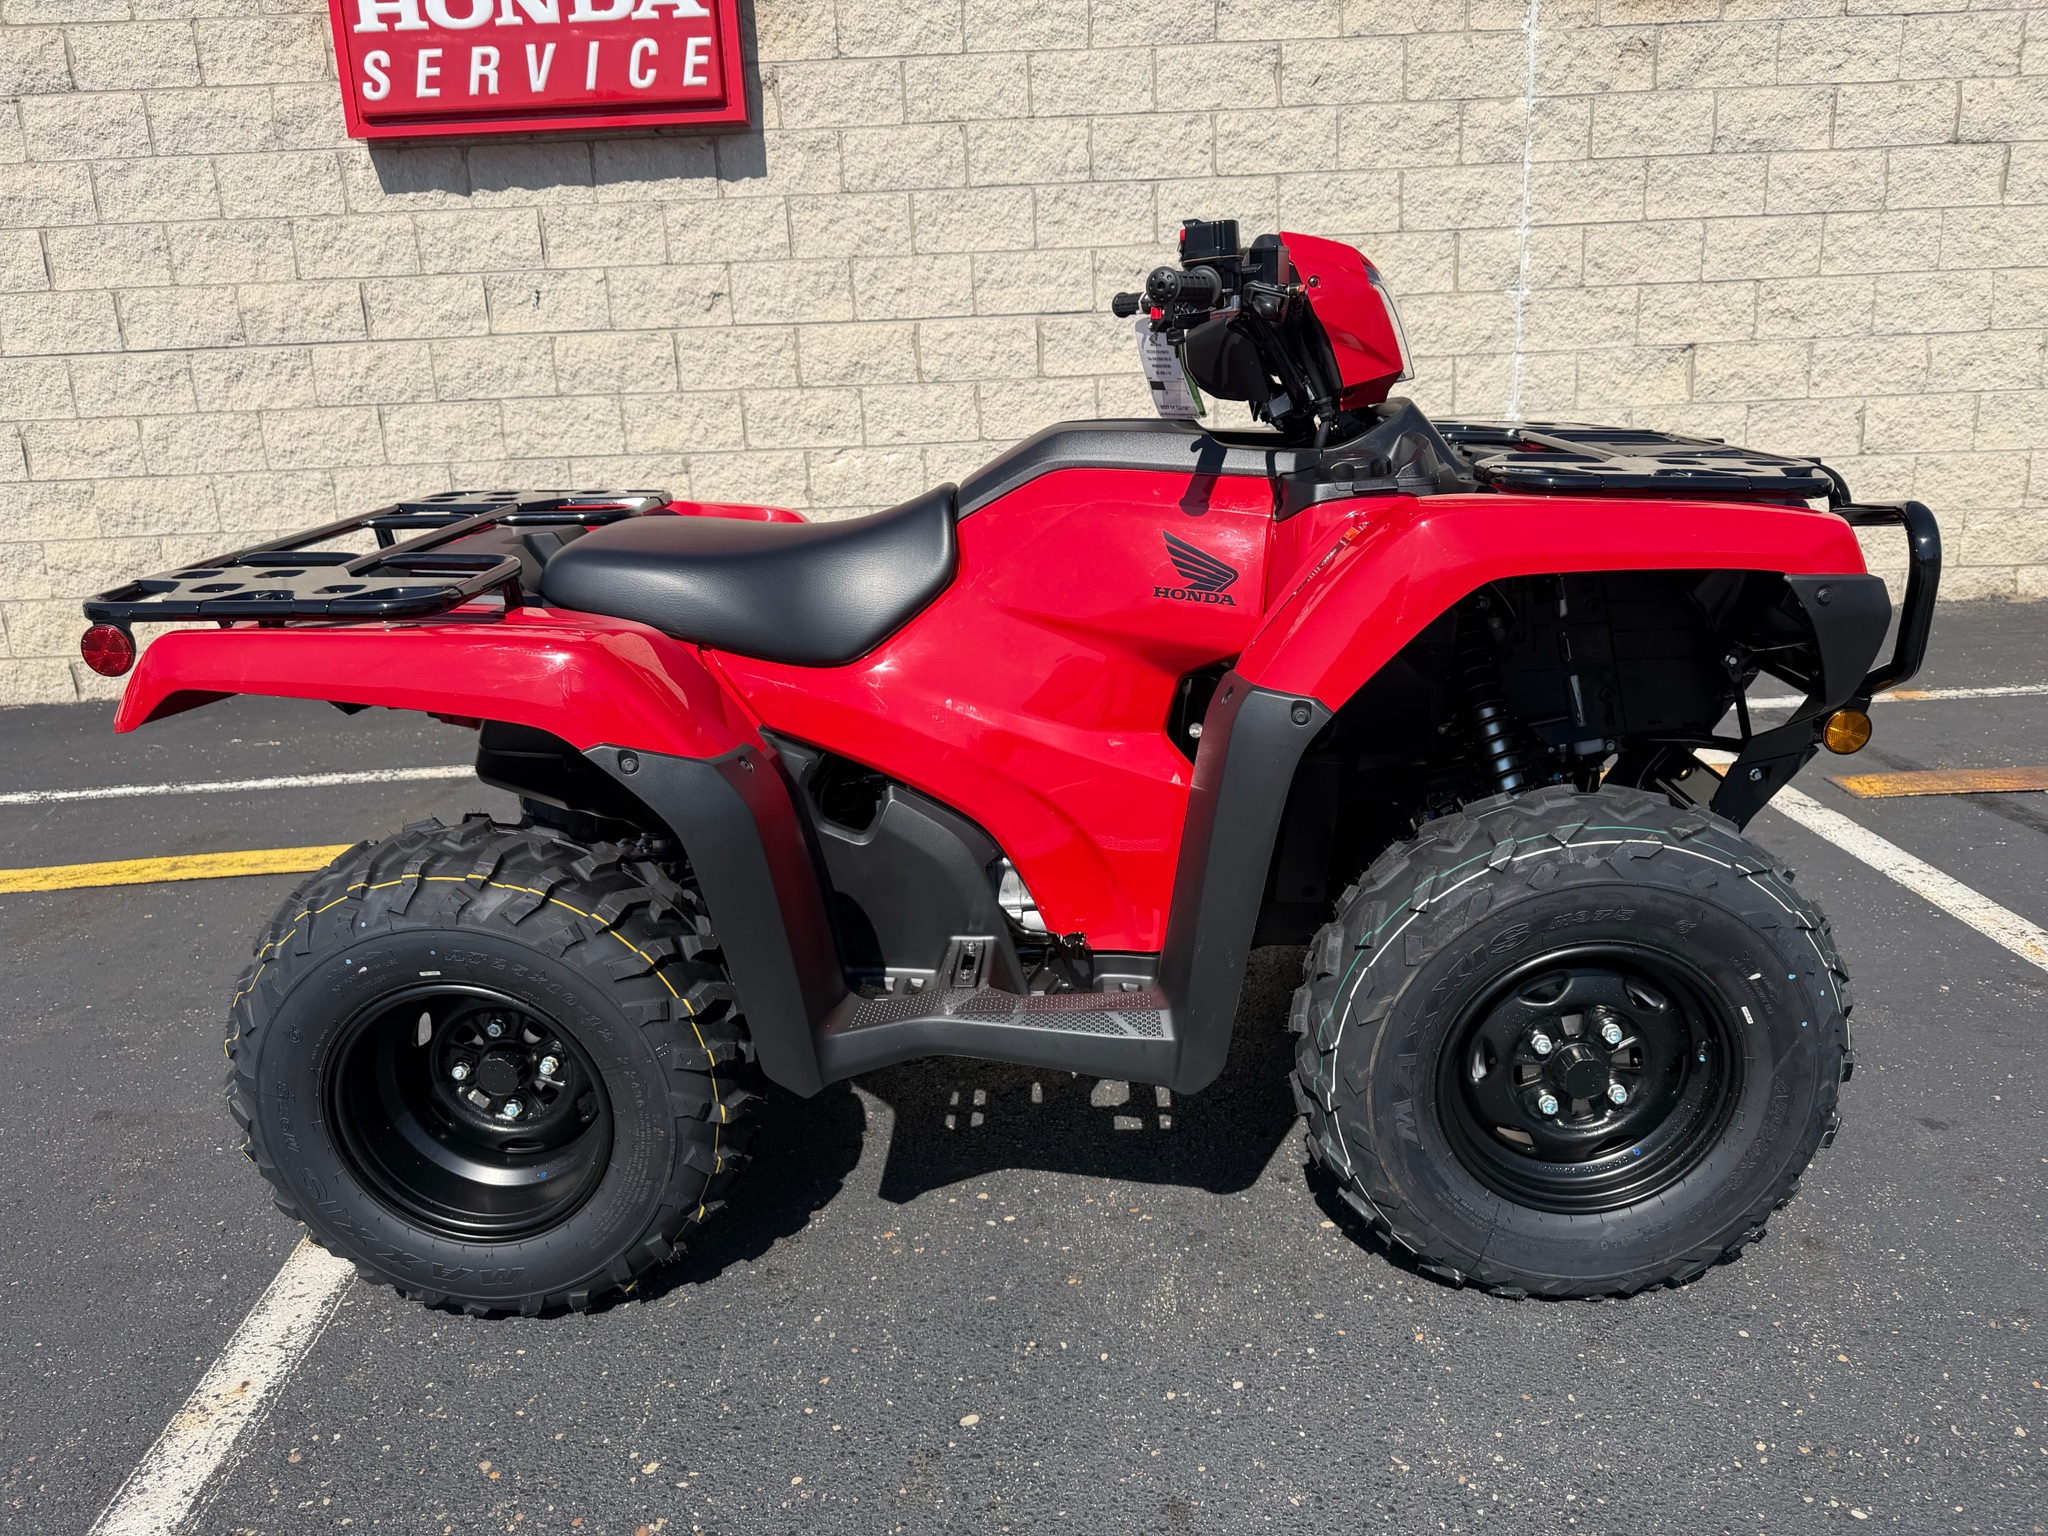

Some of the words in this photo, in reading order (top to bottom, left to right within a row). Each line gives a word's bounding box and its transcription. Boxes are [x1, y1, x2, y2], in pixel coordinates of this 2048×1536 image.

[362, 36, 712, 100] SERVICE
[1153, 587, 1237, 606] HONDA
[1393, 923, 1531, 1148] MAXXIS
[1549, 908, 1636, 931] M975
[297, 1167, 525, 1286] MAXXIS
